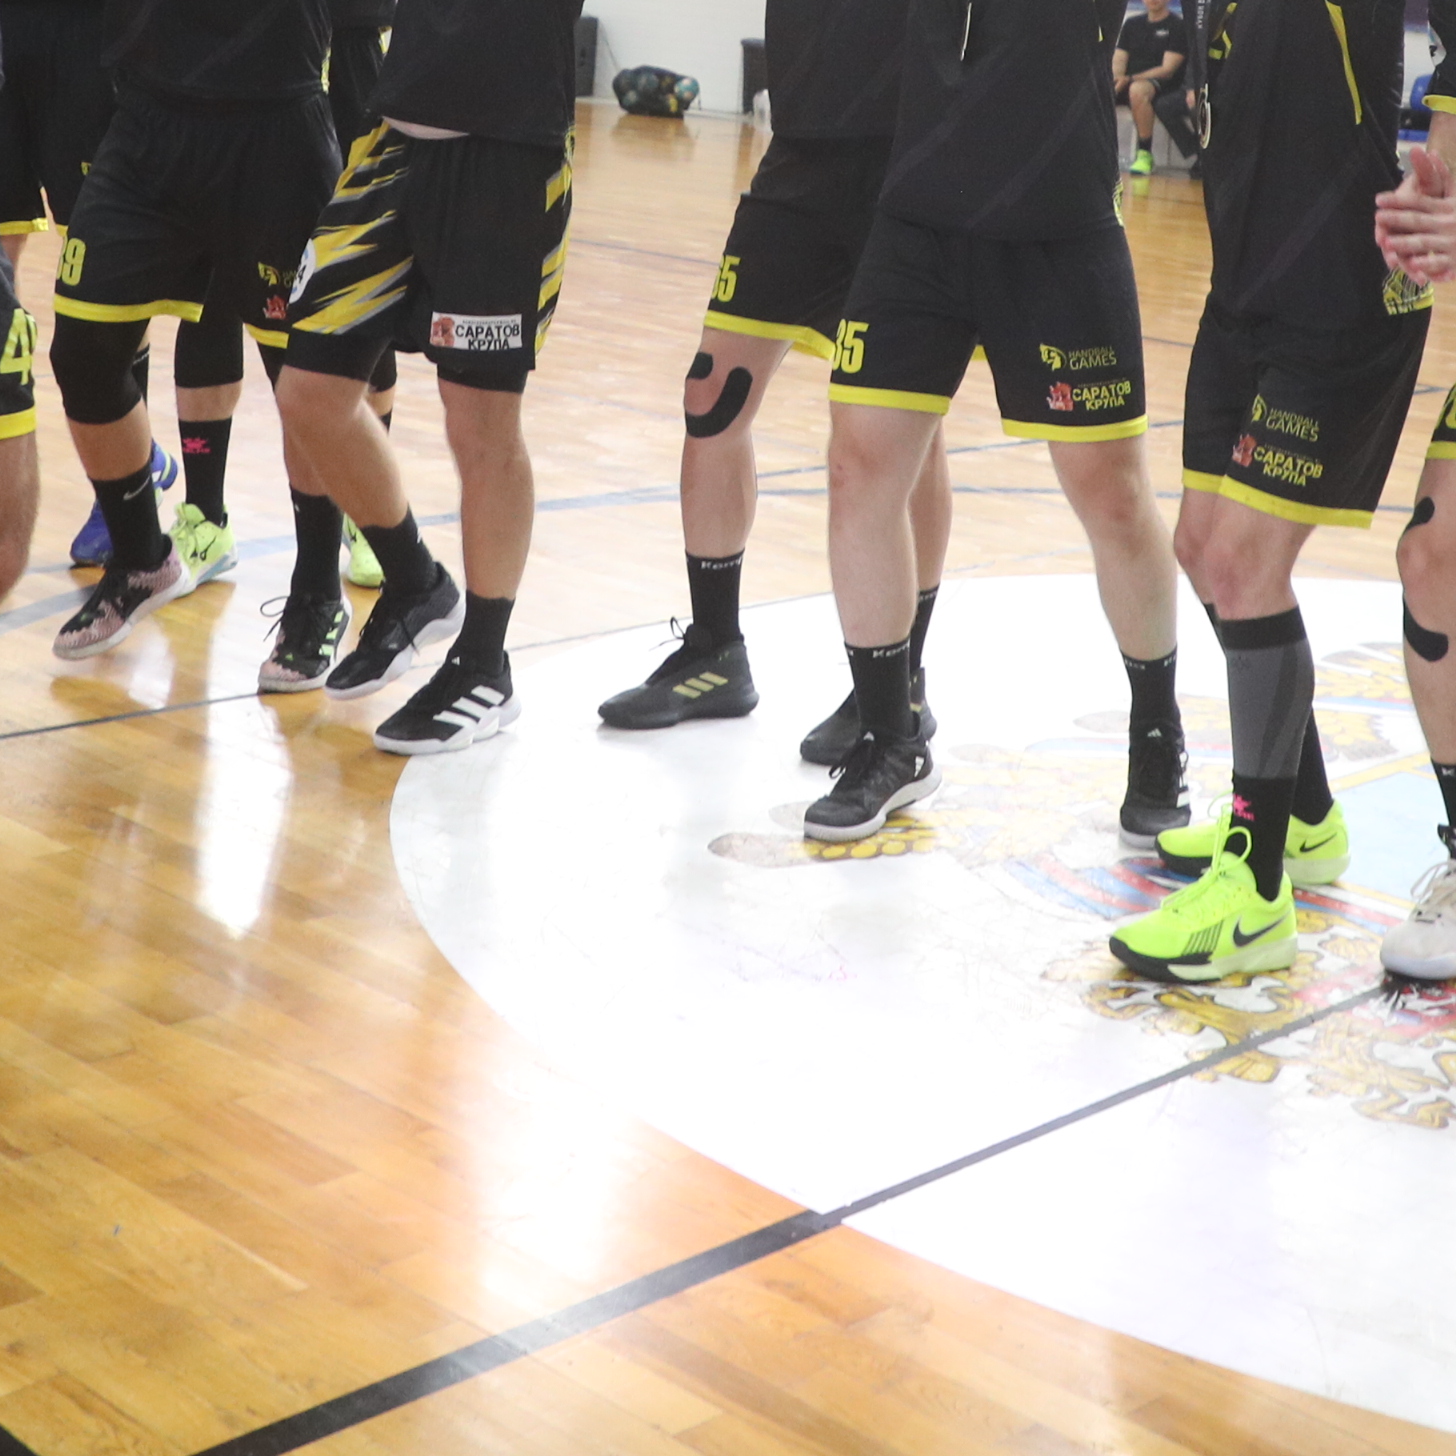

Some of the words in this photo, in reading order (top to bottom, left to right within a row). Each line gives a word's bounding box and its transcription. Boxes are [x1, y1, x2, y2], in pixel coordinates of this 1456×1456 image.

[455, 323, 521, 338] САРАТОВ
[467, 337, 510, 351] КРУПА
[1069, 352, 1118, 371] GAMES
[1072, 380, 1132, 402] САРАТОВ
[1085, 395, 1125, 411] КРУПА
[1265, 415, 1320, 443] GAMES
[1253, 445, 1324, 479] САРАТОВ
[1262, 462, 1307, 487] КРУПА
